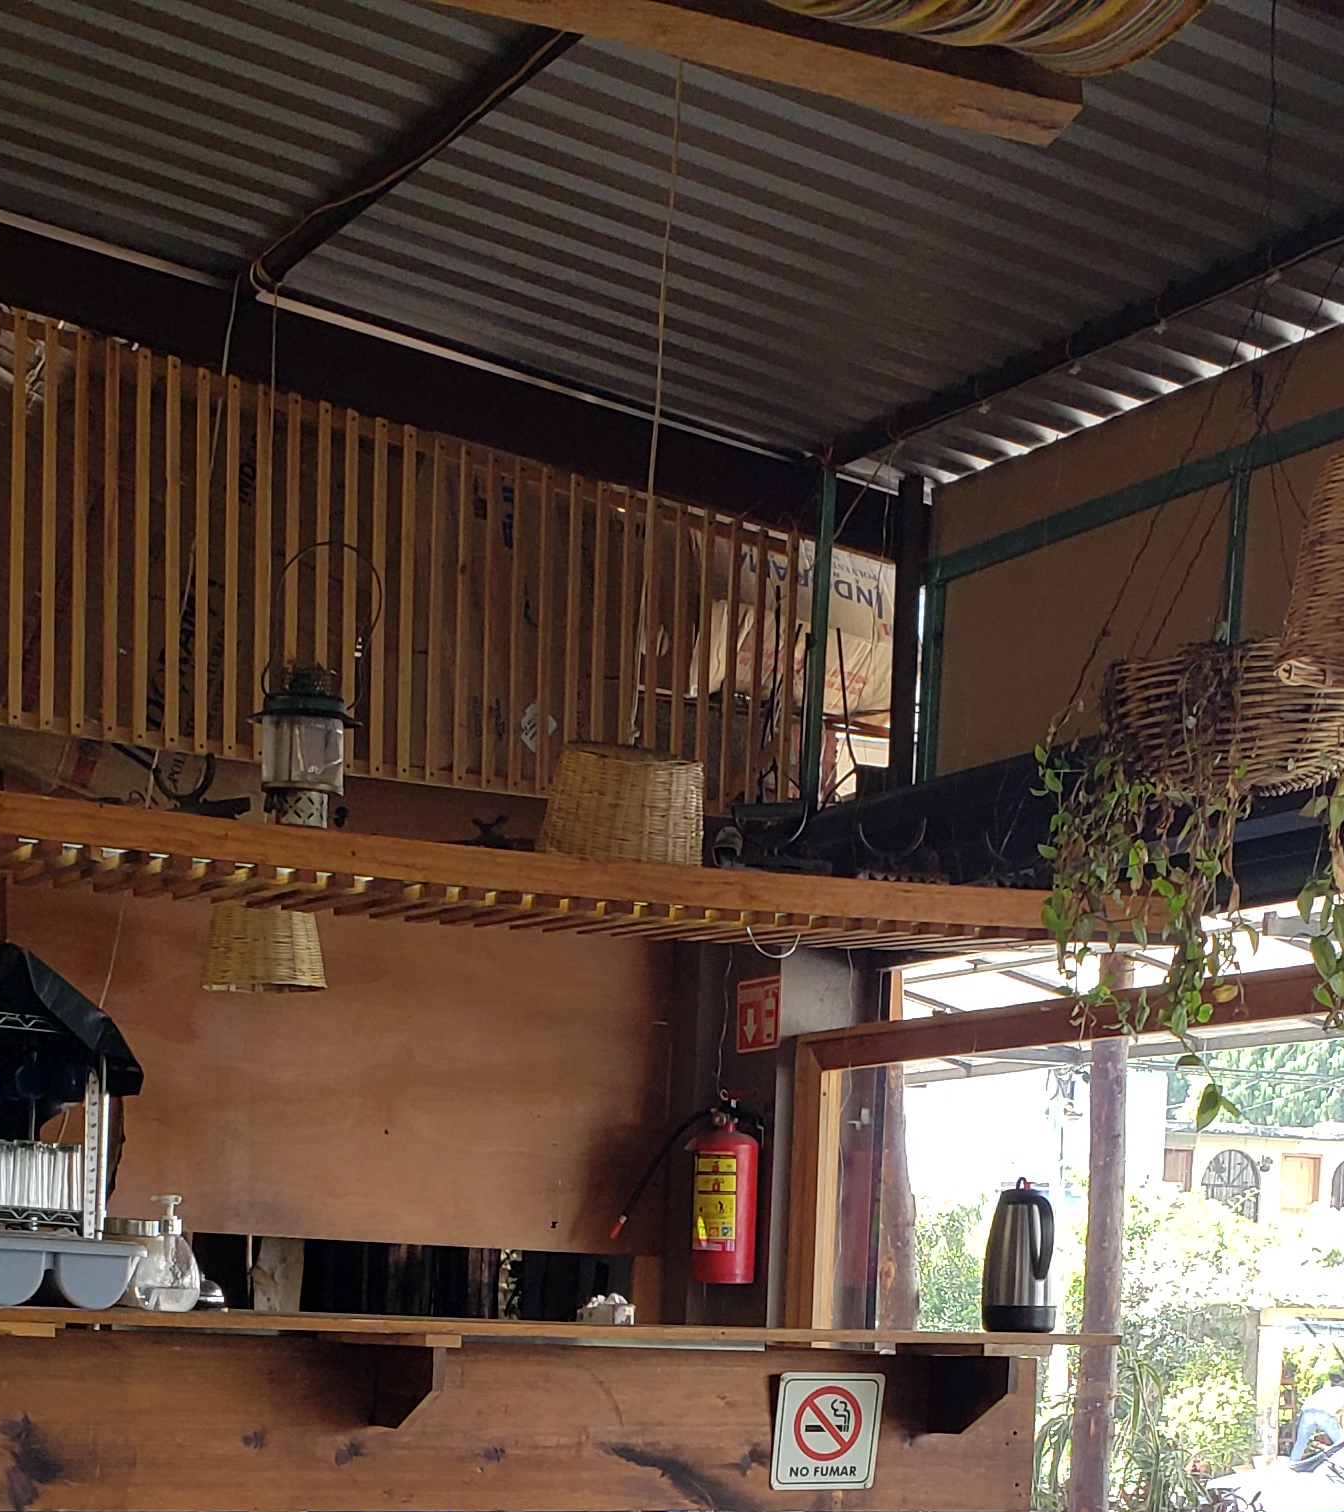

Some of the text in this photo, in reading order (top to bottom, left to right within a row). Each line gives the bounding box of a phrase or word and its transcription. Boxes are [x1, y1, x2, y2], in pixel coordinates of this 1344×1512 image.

[832, 561, 878, 582] POLYEST
[789, 1465, 857, 1477] NO FUMAR
